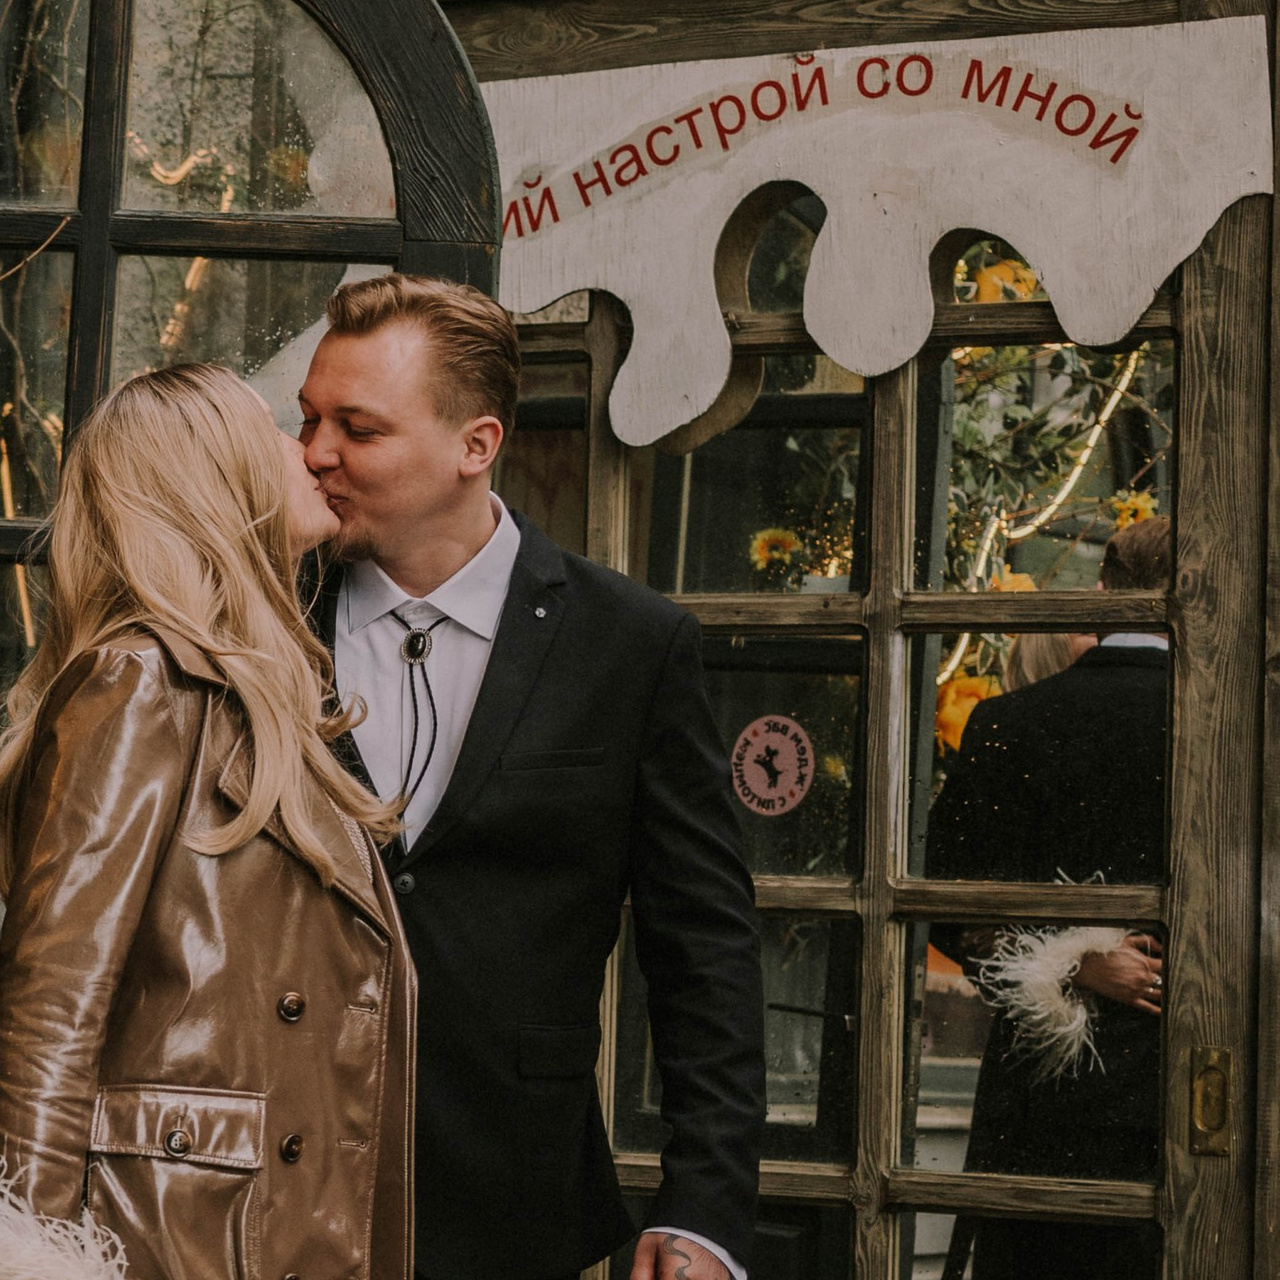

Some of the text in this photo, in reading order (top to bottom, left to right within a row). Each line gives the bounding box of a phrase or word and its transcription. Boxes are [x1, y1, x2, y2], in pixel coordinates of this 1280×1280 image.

[572, 54, 830, 207] настрой
[857, 54, 934, 99] со
[960, 58, 1141, 164] мной
